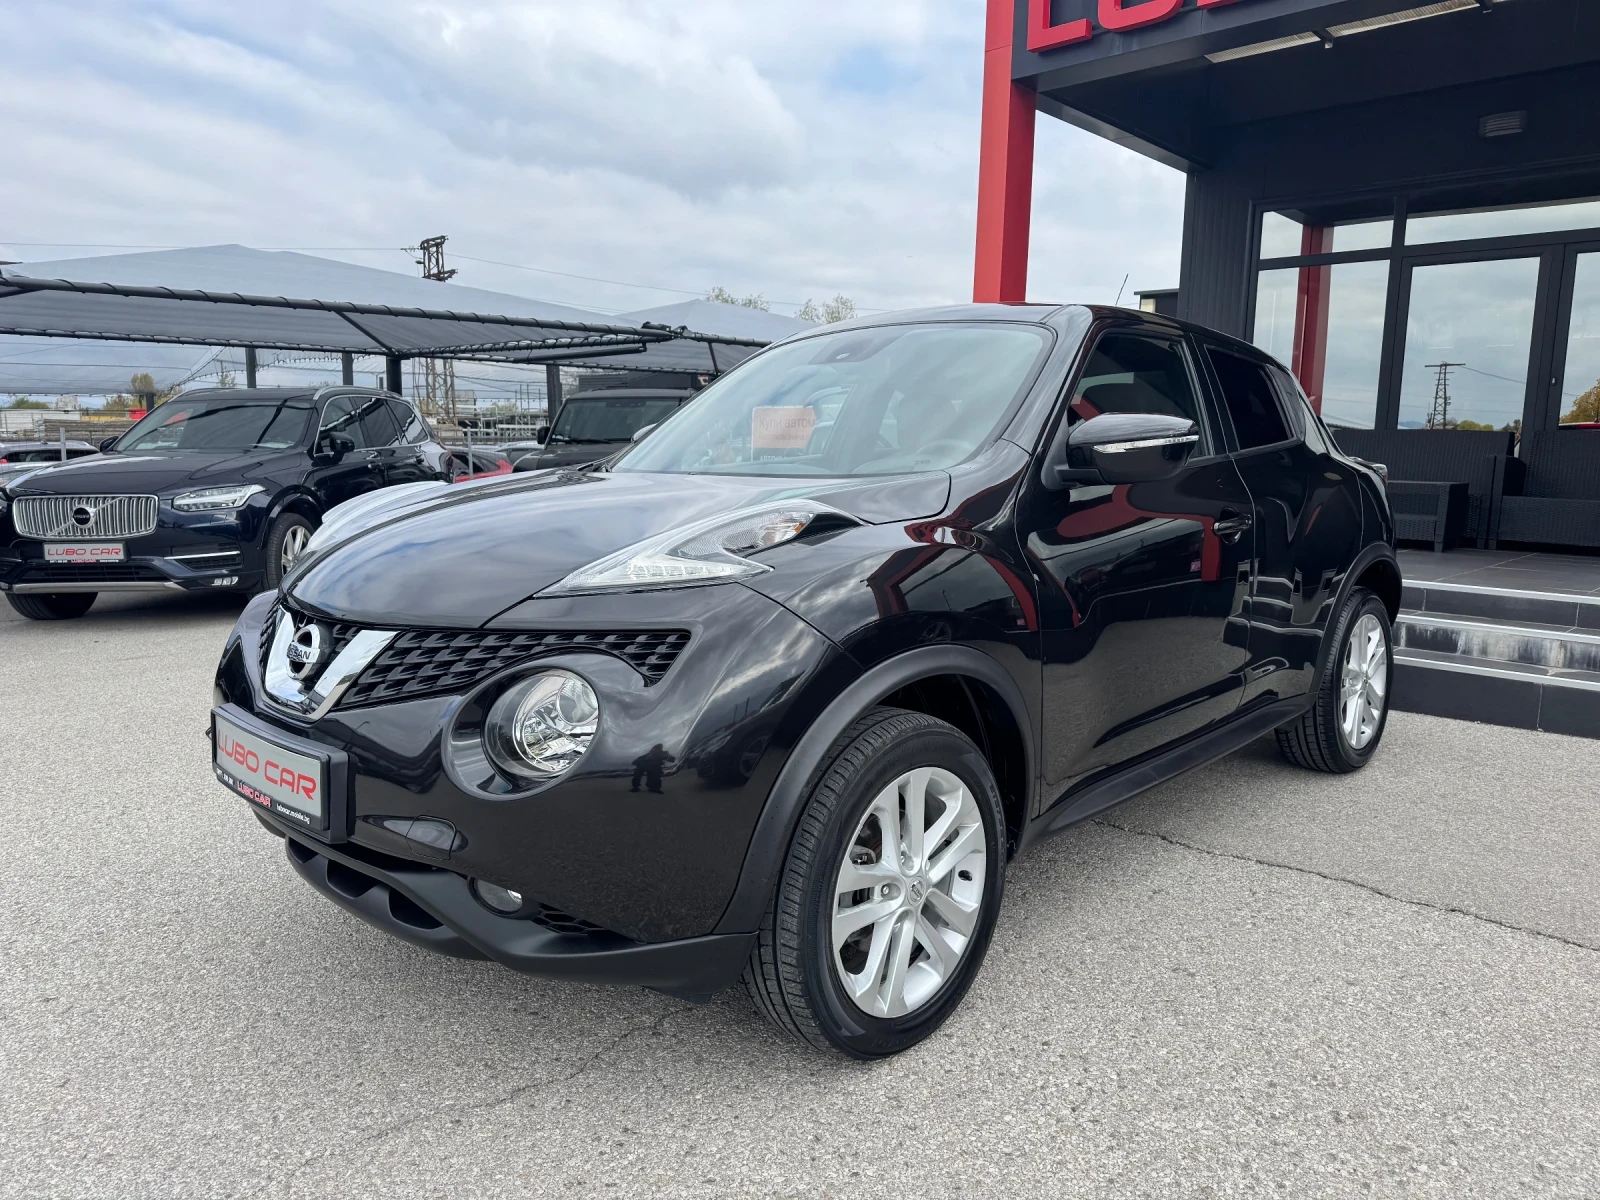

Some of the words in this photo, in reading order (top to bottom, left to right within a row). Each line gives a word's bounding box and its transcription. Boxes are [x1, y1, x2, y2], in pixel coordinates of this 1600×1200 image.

[47, 548, 87, 556] LUBO
[90, 548, 122, 556] CAR
[217, 729, 259, 773] LUBO
[264, 759, 317, 800] CAR
